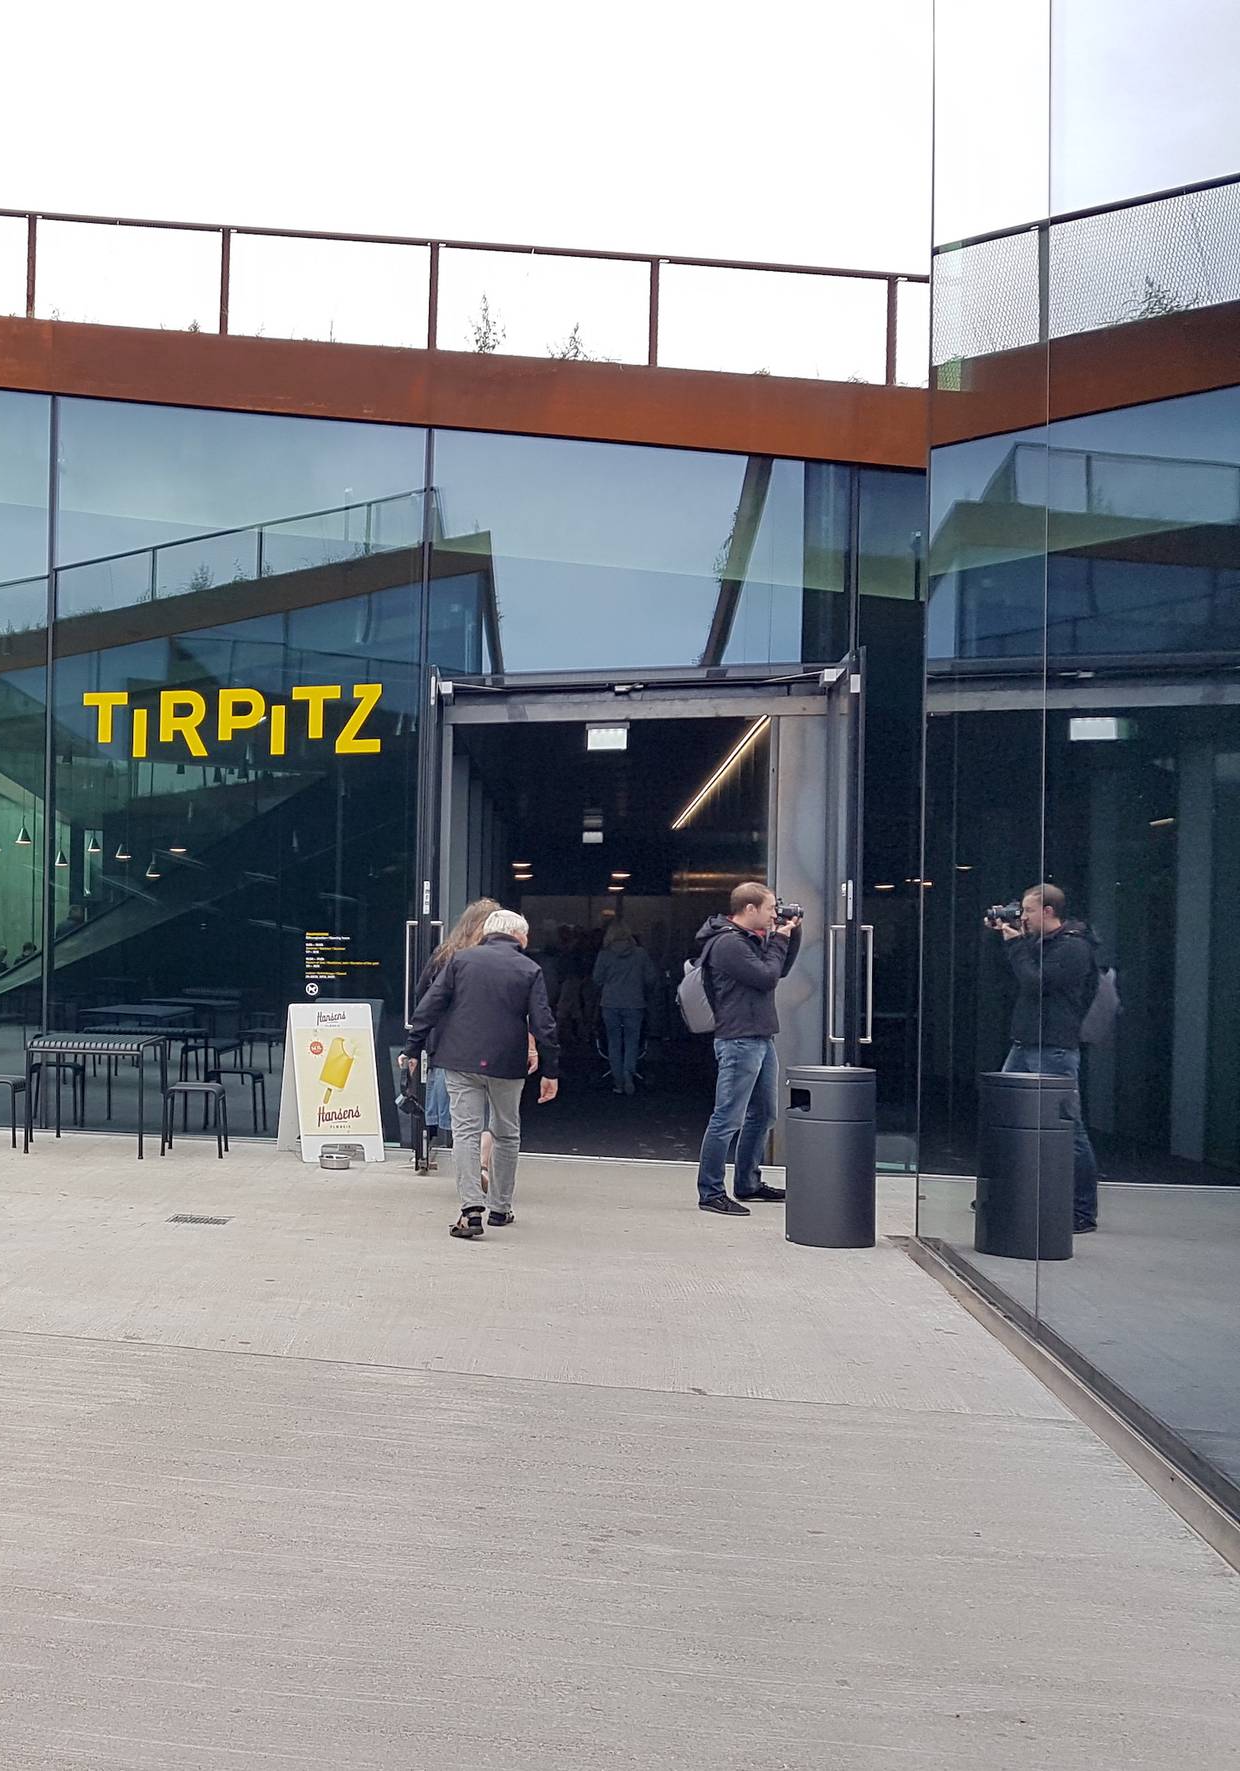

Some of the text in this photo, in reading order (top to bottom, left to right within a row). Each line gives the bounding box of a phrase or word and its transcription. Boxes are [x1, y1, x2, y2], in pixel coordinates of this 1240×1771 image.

[83, 684, 382, 757] TIRPITZ
[317, 1011, 347, 1026] Hansens
[317, 1105, 362, 1127] Hansens
